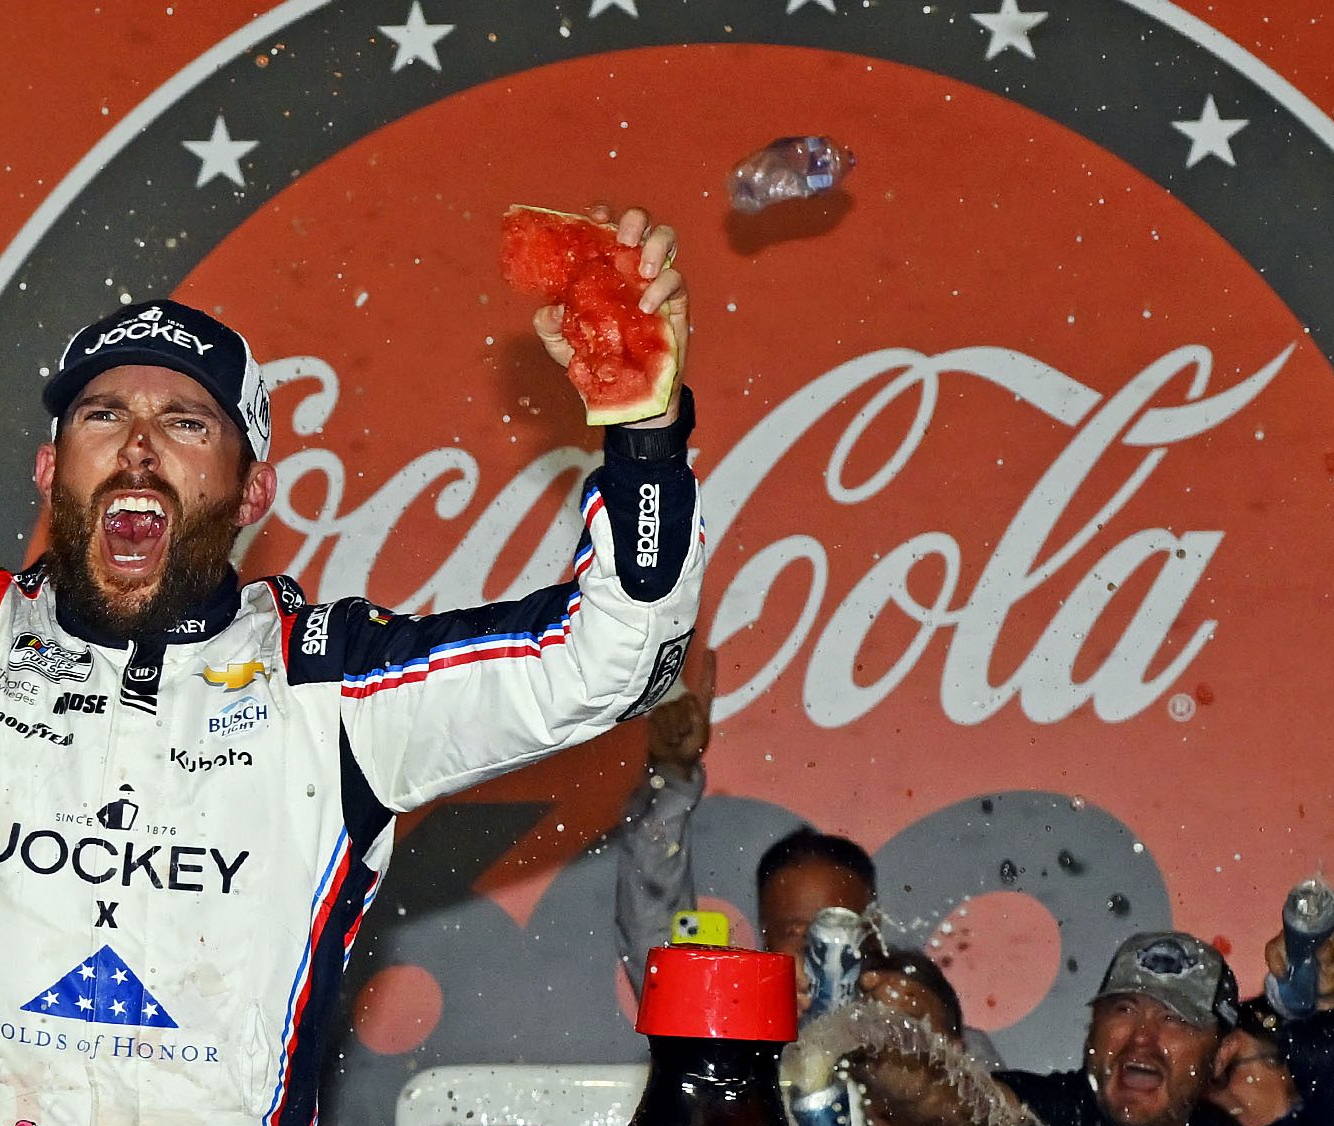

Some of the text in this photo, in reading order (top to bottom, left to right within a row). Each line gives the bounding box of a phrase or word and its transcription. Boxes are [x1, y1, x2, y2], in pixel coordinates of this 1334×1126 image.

[84, 321, 214, 356] JOCKEY
[636, 483, 660, 567] sparco
[208, 705, 267, 733] BUSCH
[222, 721, 256, 737] LIGHT
[170, 748, 252, 772] Kubota
[56, 812, 177, 836] SINCE 1876
[77, 1035, 104, 1059] of
[113, 1037, 219, 1063] HONOR
